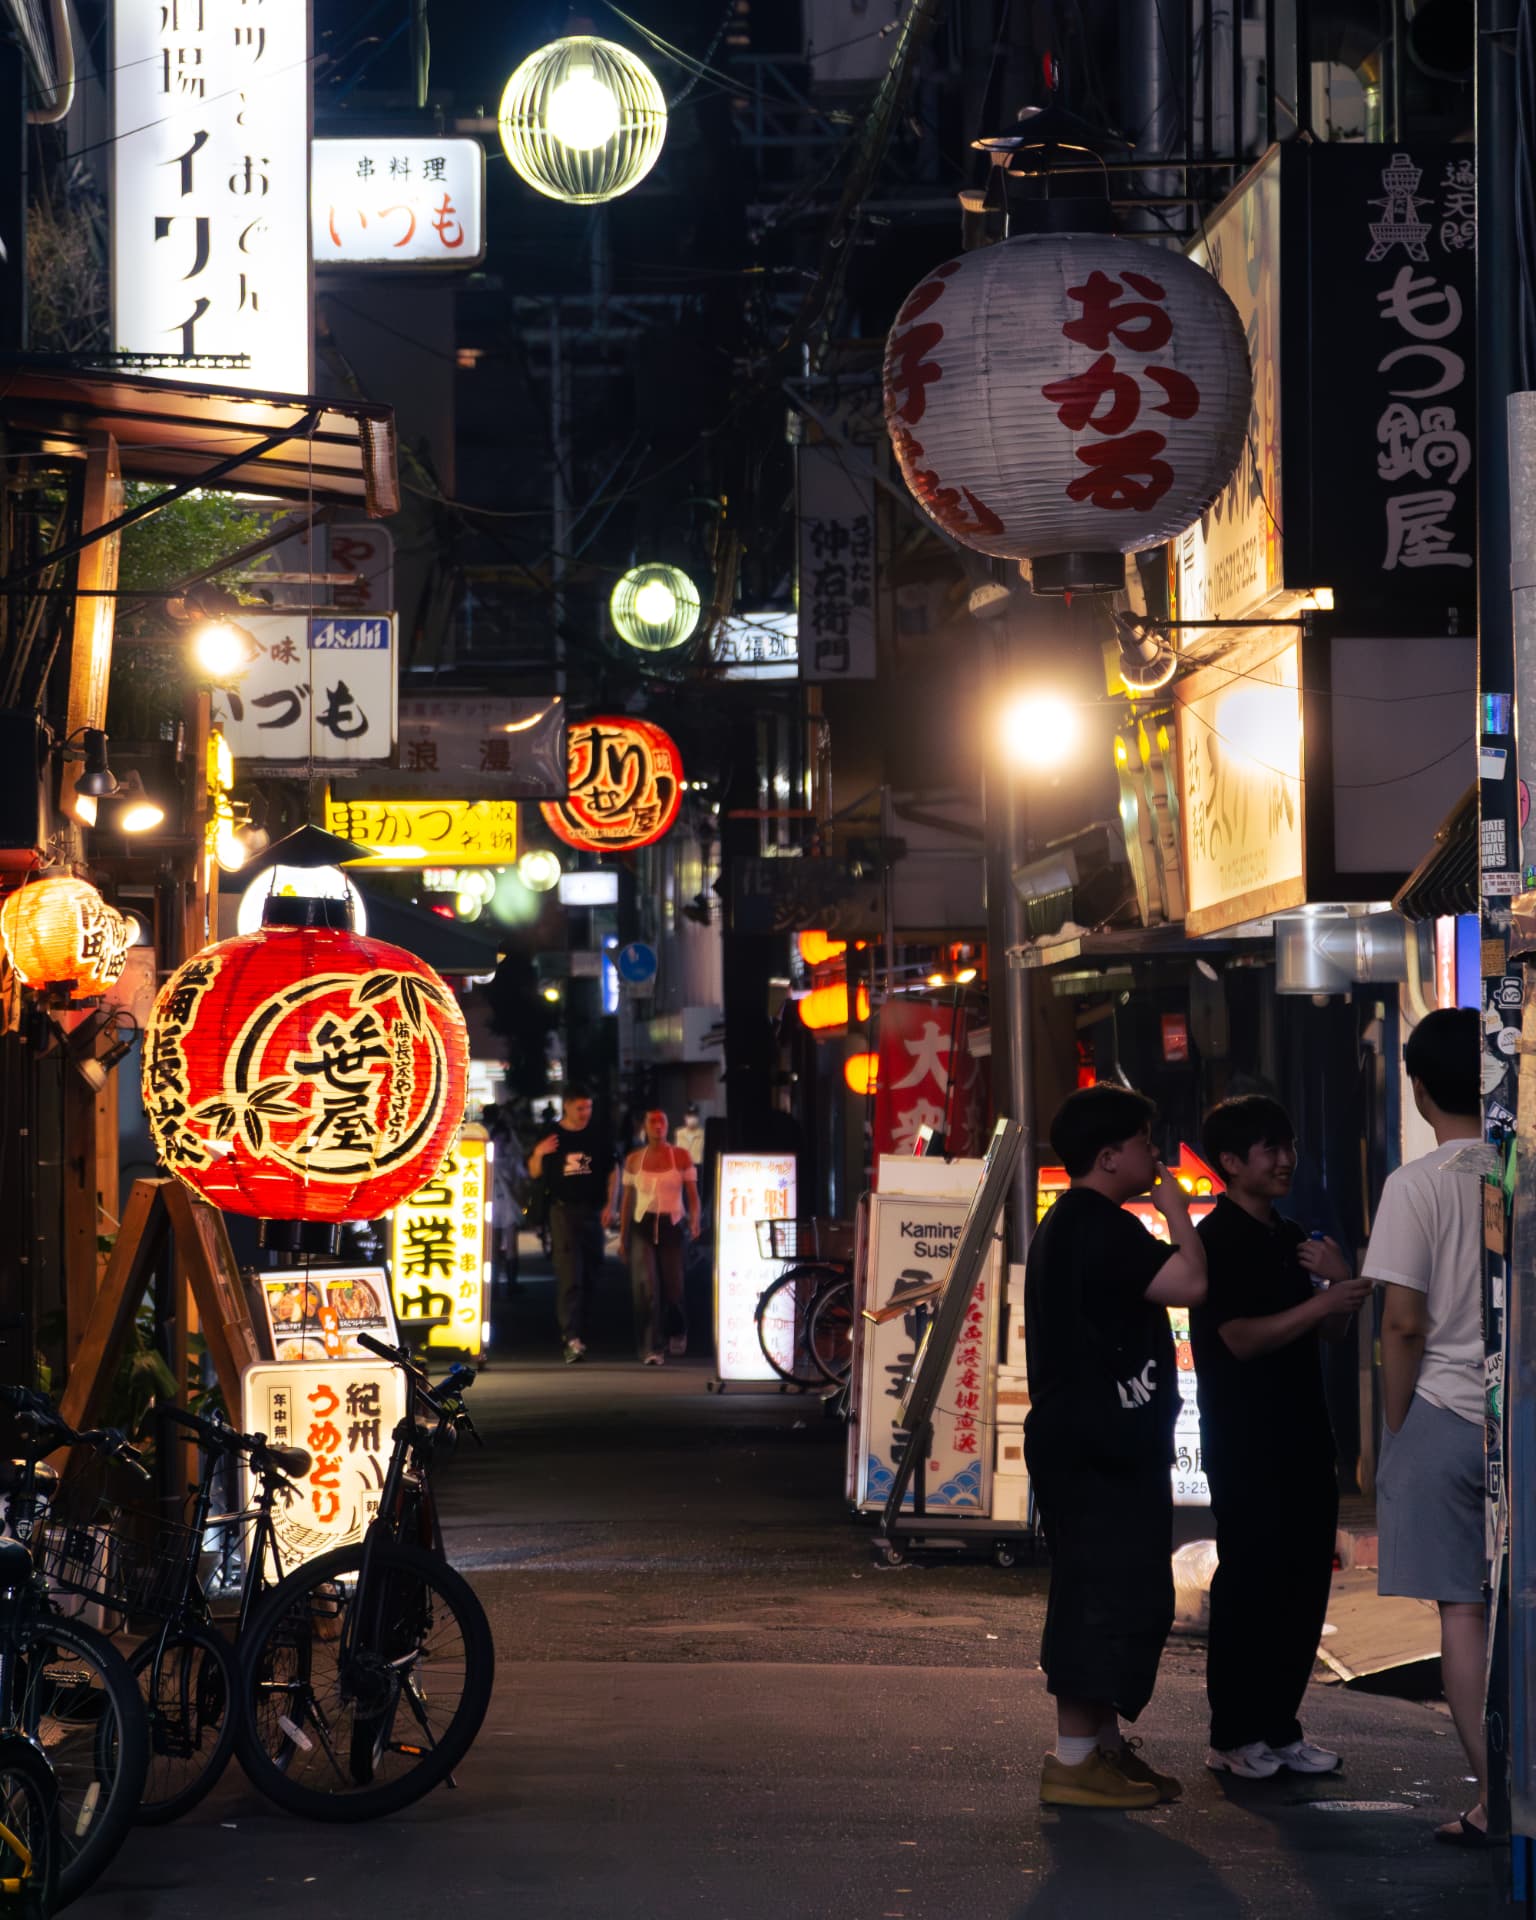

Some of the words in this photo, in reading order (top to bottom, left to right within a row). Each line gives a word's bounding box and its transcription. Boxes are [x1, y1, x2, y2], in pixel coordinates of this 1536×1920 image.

[356, 156, 448, 183] 串料理
[1041, 270, 1200, 512] おかる
[1376, 265, 1472, 570] もつ鍋屋
[314, 621, 382, 649] Asahi
[332, 807, 453, 844] 串かつ
[294, 1013, 391, 1154] 笹屋
[273, 1392, 288, 1448] 年中無
[307, 1384, 343, 1524] うめどり
[345, 1382, 382, 1459] 紀州
